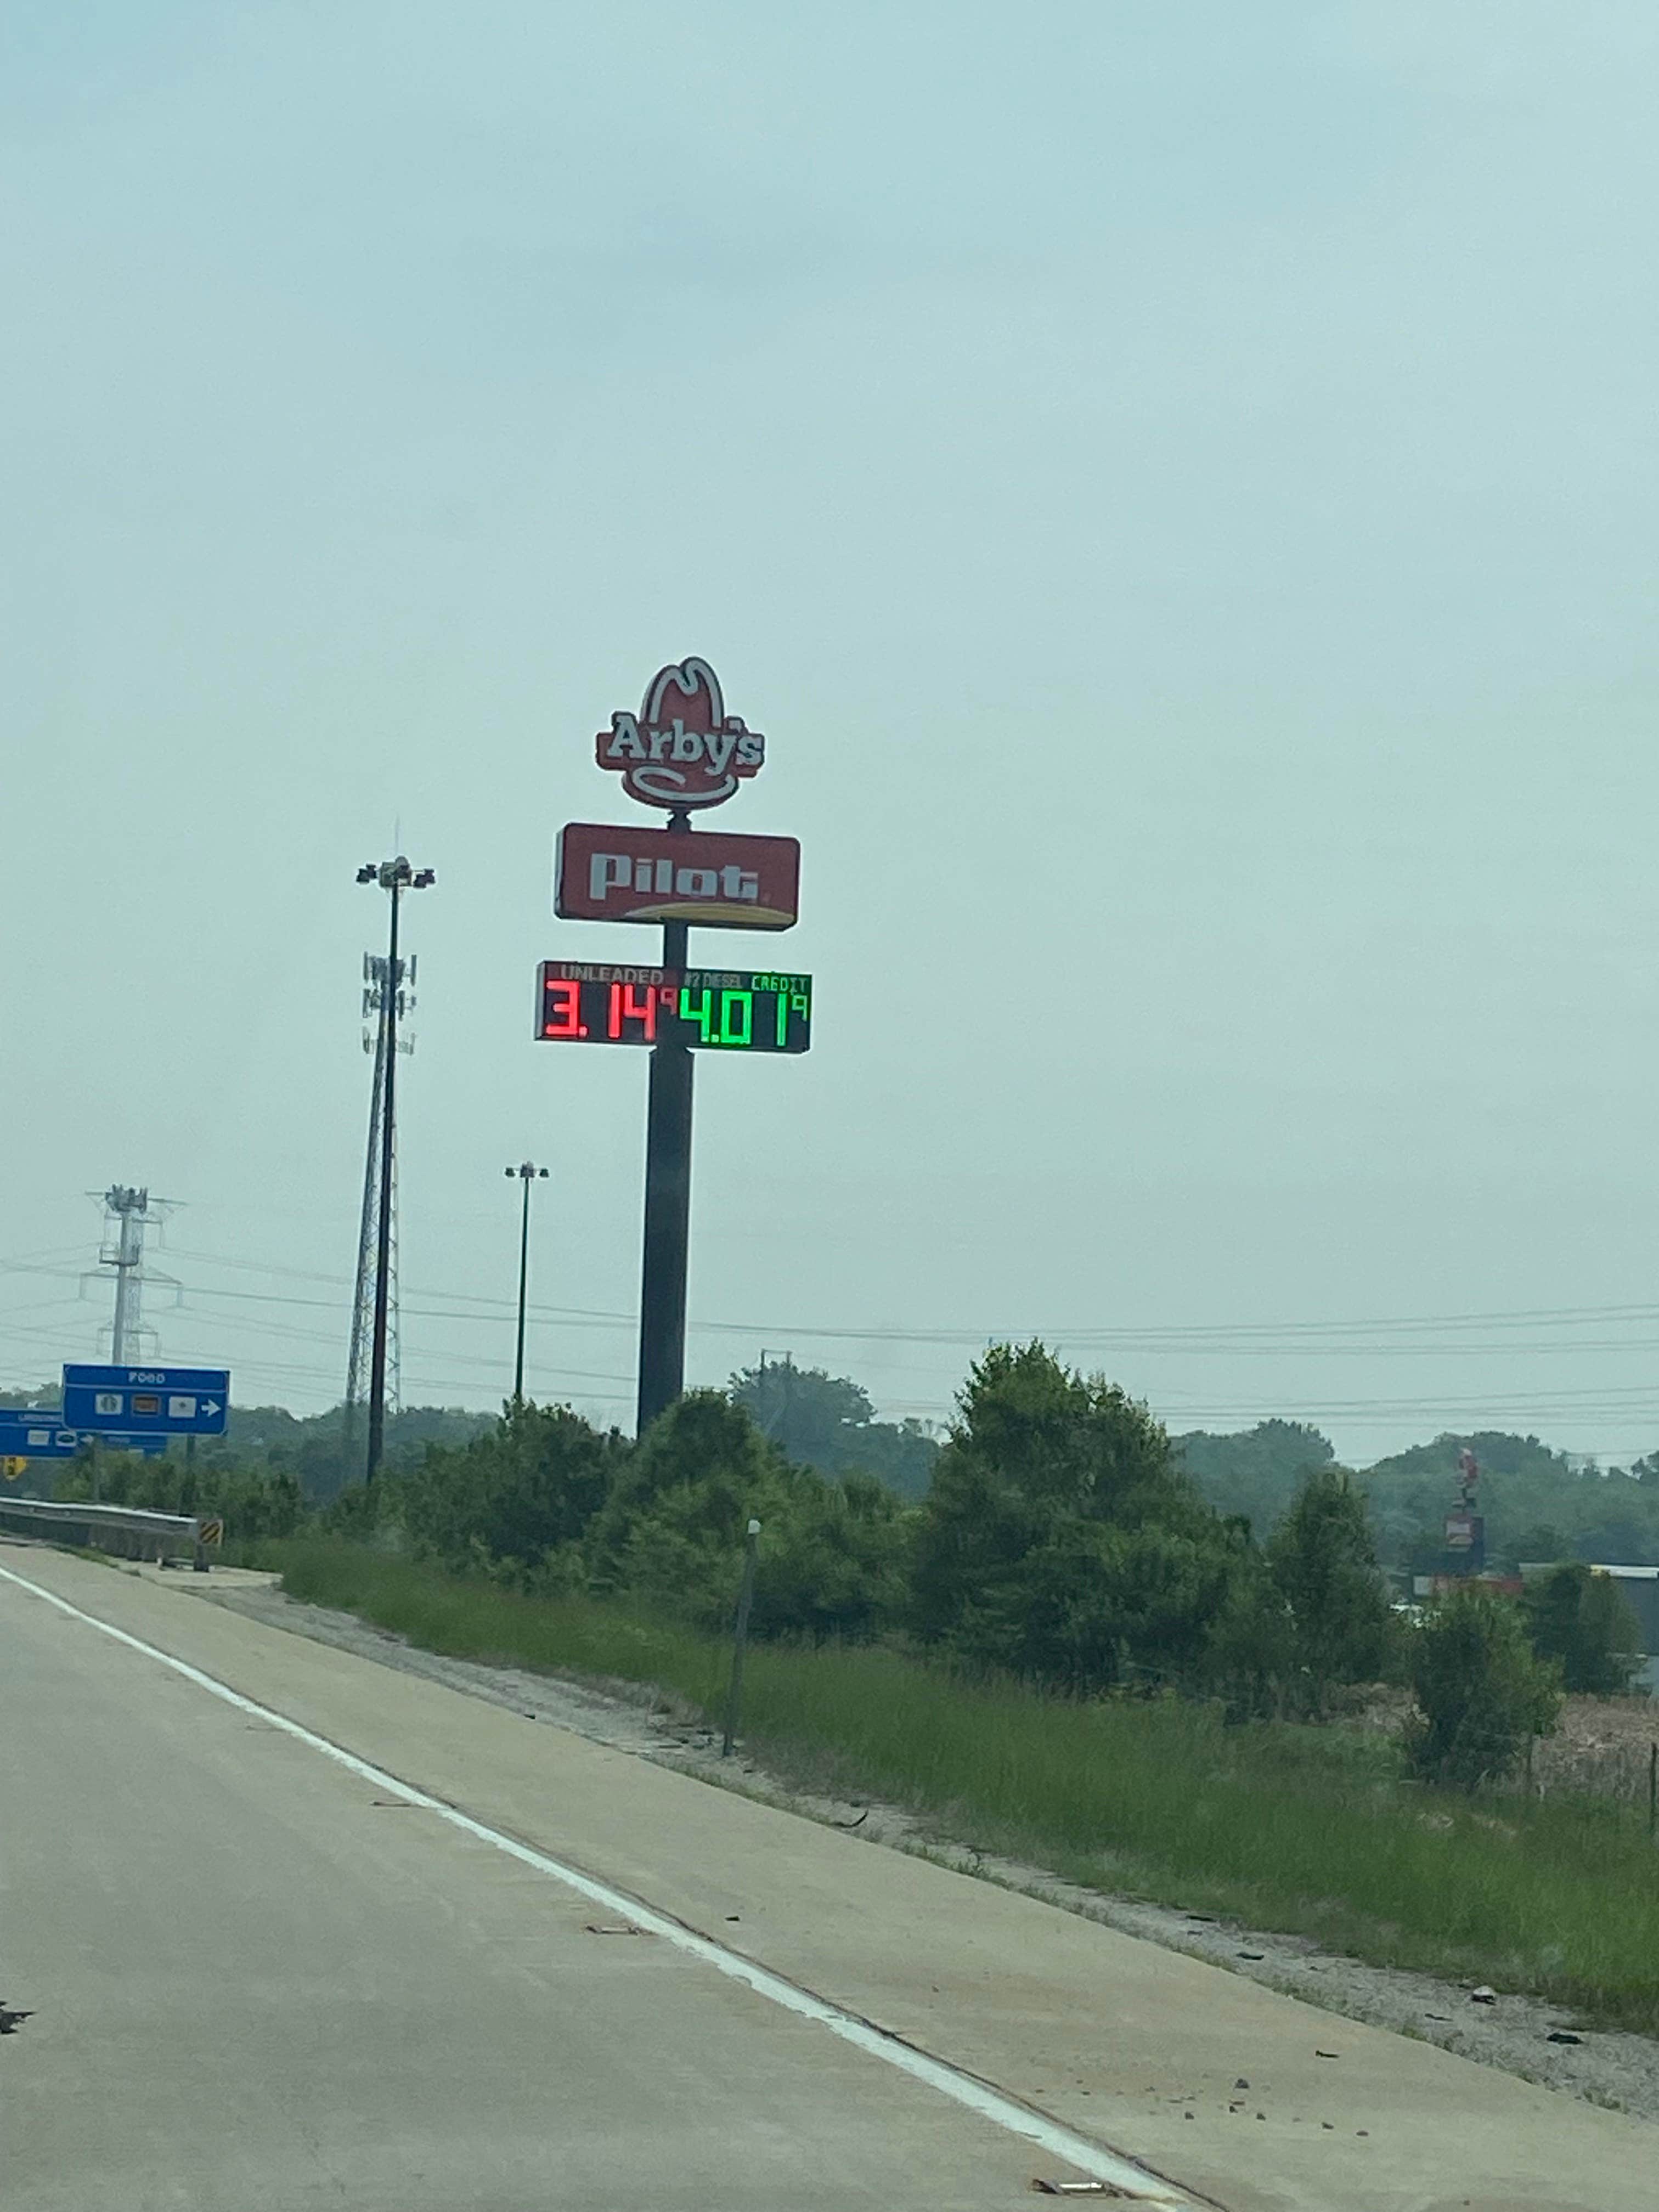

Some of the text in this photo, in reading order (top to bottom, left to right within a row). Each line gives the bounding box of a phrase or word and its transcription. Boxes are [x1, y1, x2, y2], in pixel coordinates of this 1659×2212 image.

[607, 716, 761, 776] Arby's
[590, 853, 758, 900] Pilot
[561, 964, 664, 985] UNLEADED
[752, 975, 809, 995] CREDIT
[128, 1372, 165, 1384] FOOD
